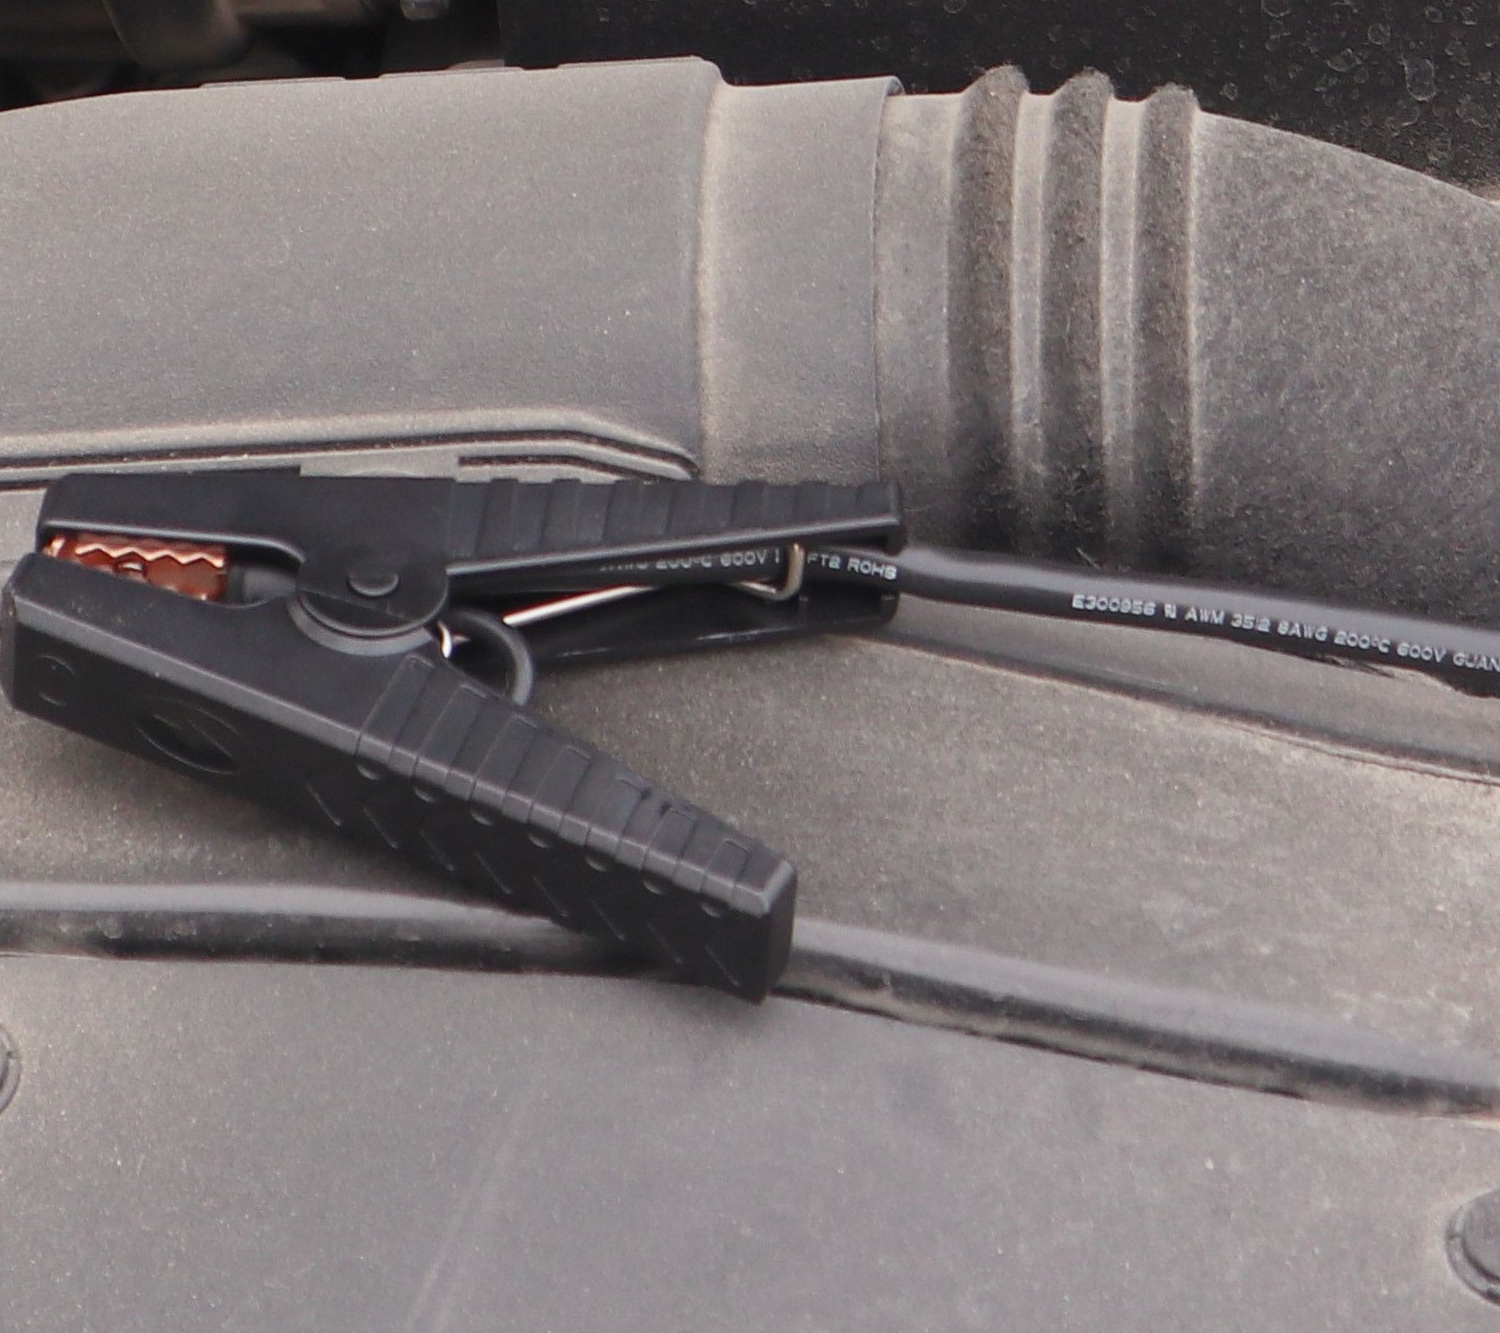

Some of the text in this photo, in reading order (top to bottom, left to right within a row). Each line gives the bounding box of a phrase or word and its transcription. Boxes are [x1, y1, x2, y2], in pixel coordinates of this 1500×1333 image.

[846, 557, 898, 581] ROHS
[1071, 592, 1156, 618] E300956
[1184, 605, 1225, 627] AWM
[1276, 621, 1329, 643] 8AWG
[1396, 641, 1448, 665] 600V
